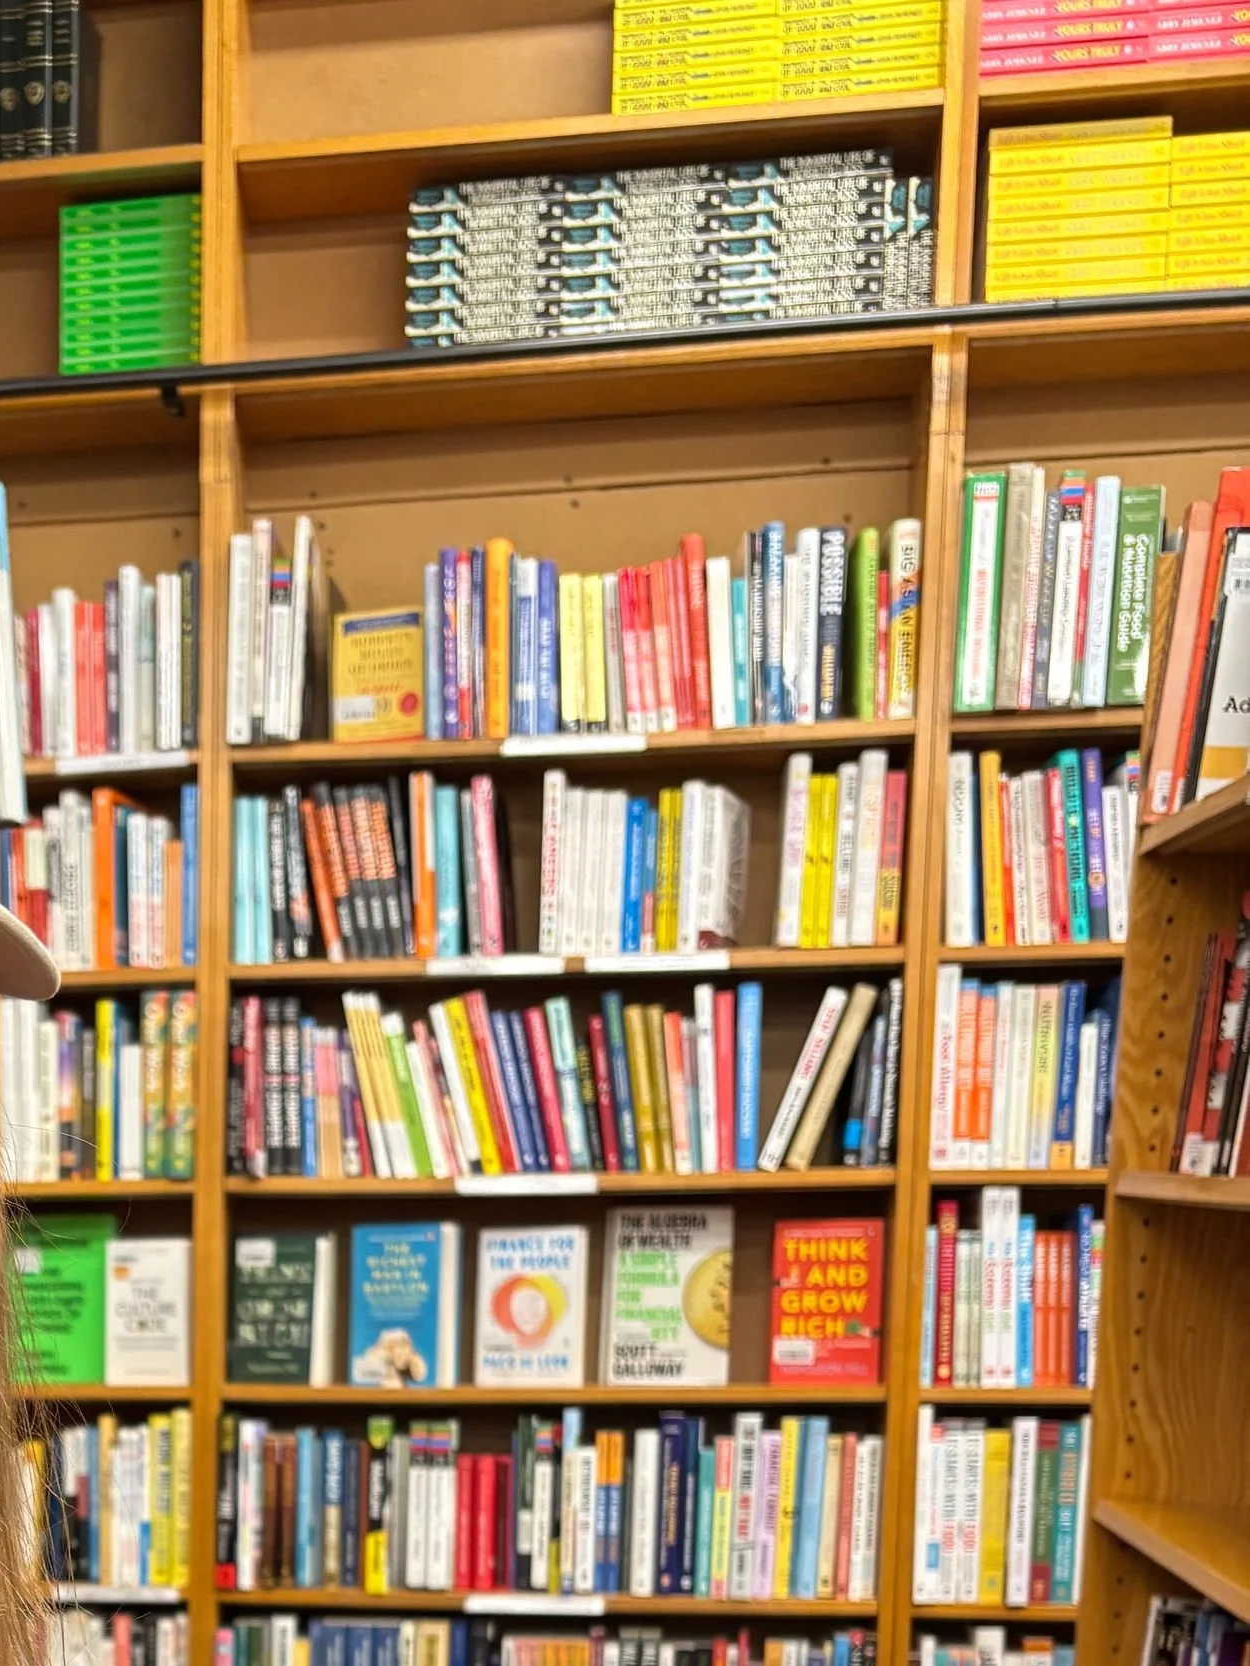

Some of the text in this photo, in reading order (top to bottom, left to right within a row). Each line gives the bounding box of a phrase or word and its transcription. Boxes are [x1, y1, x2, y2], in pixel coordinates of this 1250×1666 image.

[820, 529, 845, 618] POSSIBLE
[620, 1212, 707, 1231] THE ALGEBRA
[639, 1233, 691, 1250] WEALTH
[784, 1237, 869, 1262] THINK
[806, 1265, 869, 1288] AND
[780, 1289, 869, 1313] GROW
[780, 1315, 846, 1339] RICH
[613, 1343, 655, 1358] SCOTT
[612, 1362, 684, 1378] GALLOWAY
